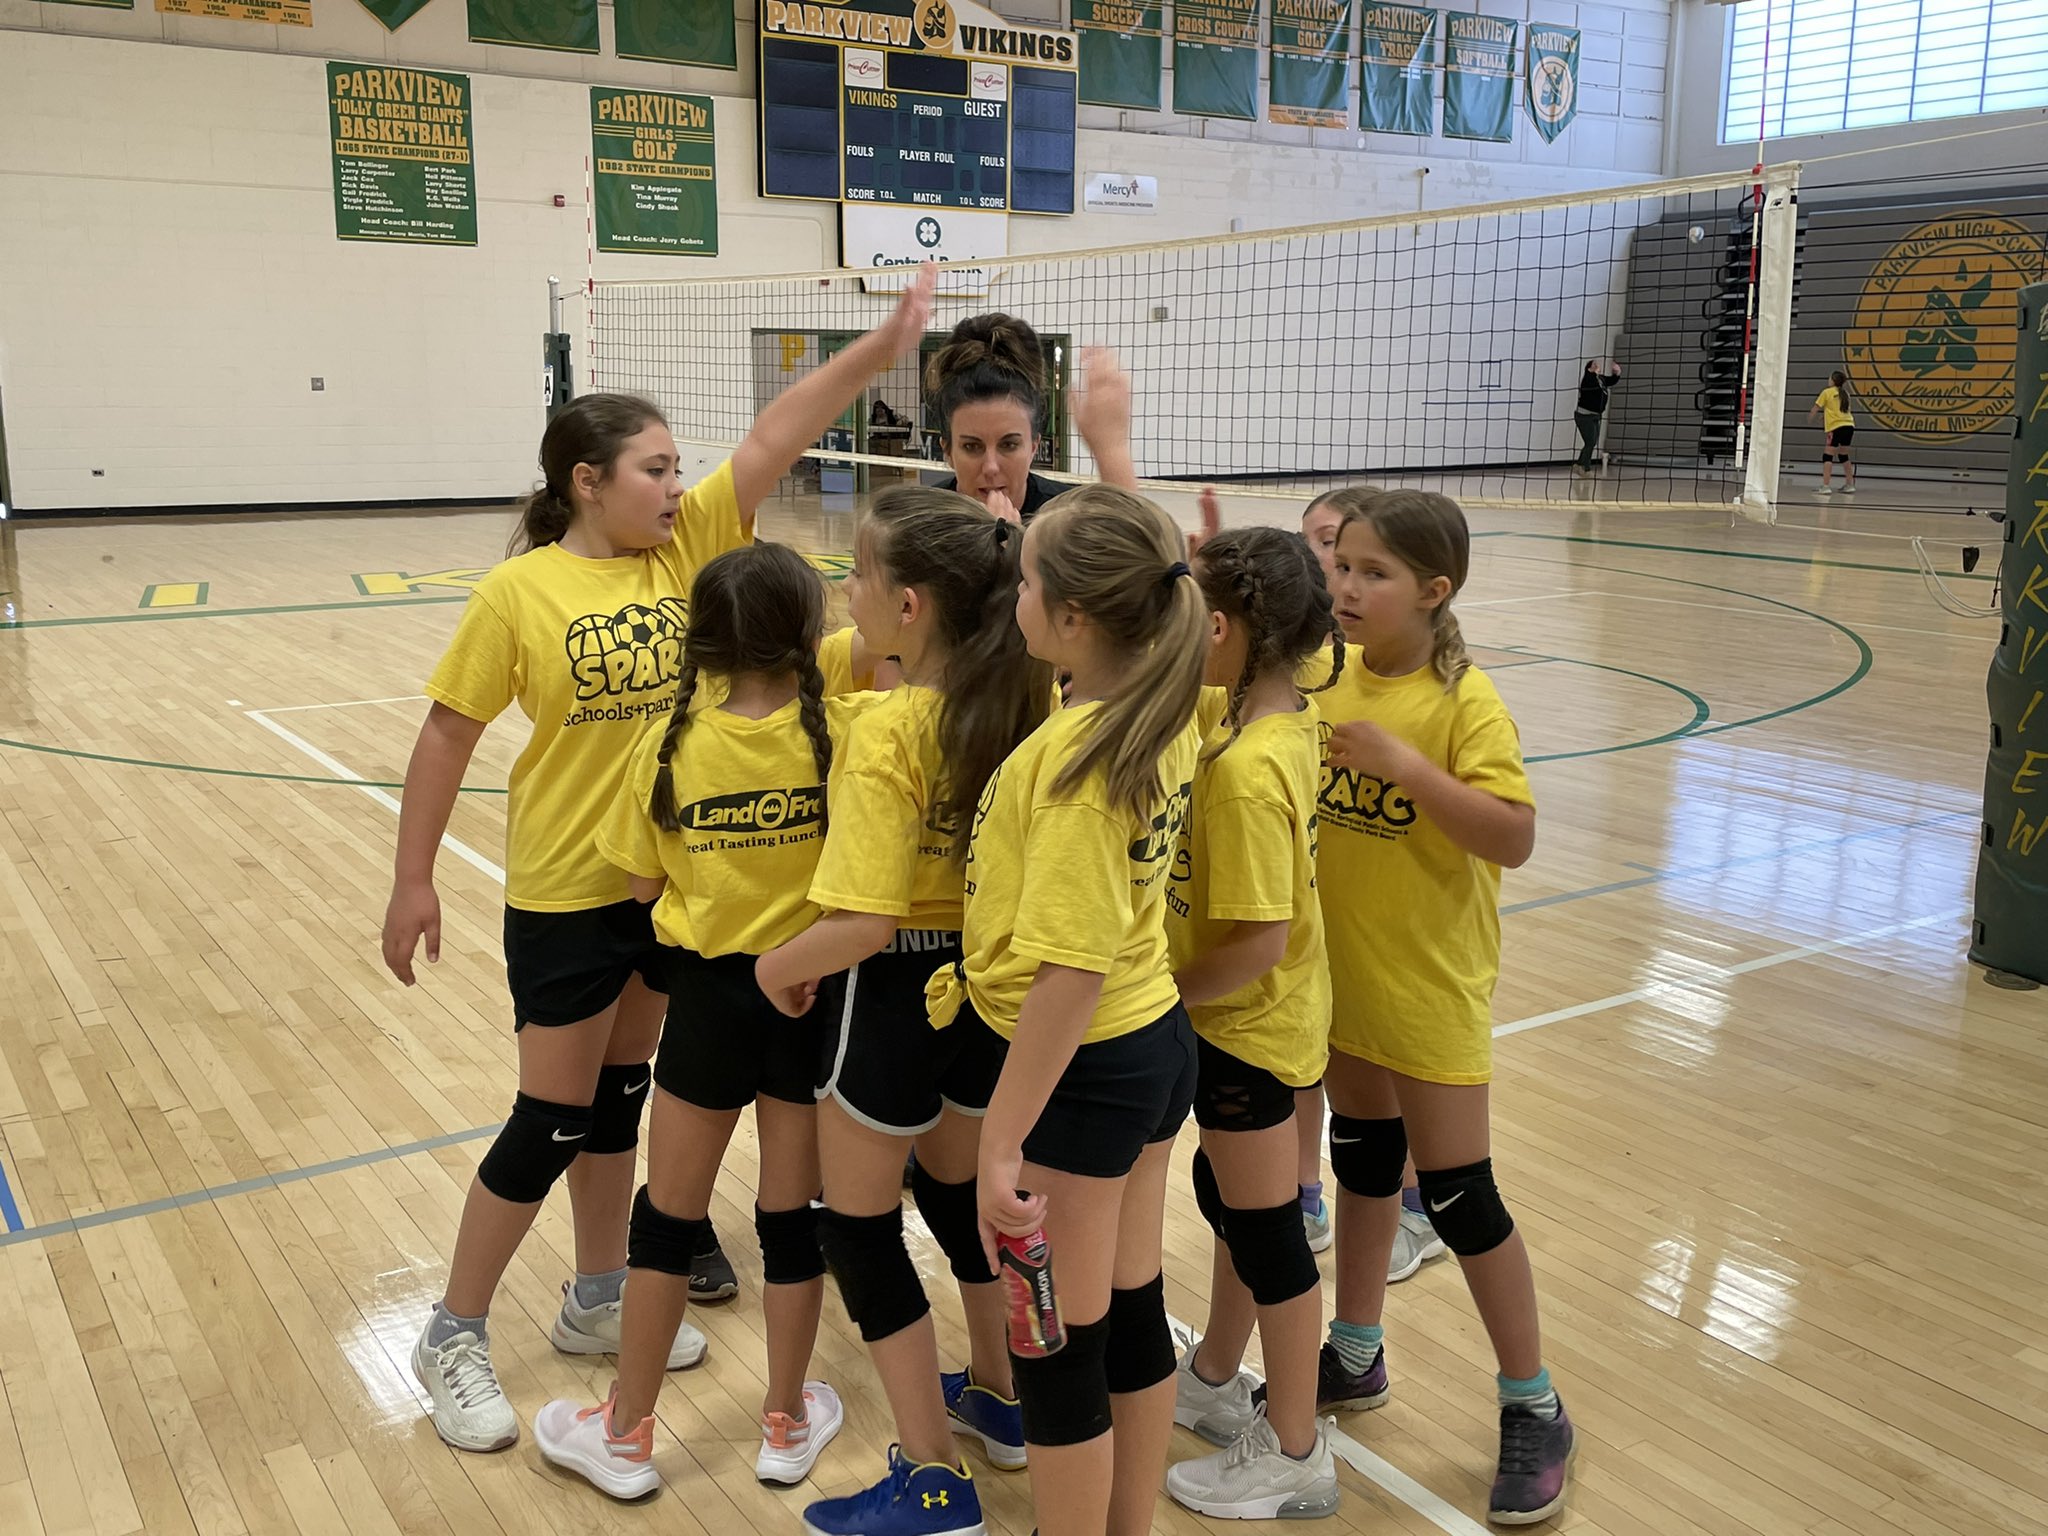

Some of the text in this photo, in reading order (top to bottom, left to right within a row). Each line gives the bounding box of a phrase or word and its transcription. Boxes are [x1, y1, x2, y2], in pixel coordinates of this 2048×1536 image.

[1092, 4, 1144, 26] SOCCER
[1206, 8, 1233, 19] GIRLS
[1277, 0, 1344, 21] PARKVIEW
[1366, 7, 1431, 32] PARKVIEW
[767, 0, 1073, 63] PARKVIEW VIKINGS
[1177, 16, 1211, 35] CROSS
[1215, 19, 1259, 40] COUNTRY
[1300, 20, 1325, 32] GIRLS
[1452, 17, 1514, 43] PARKVIEW
[1298, 31, 1327, 48] GOLF
[1388, 32, 1411, 44] GIRLS
[1532, 32, 1578, 53] PARKVIEW
[1456, 50, 1507, 69] SOFTBALL
[335, 69, 462, 106] PARKVIEW
[849, 90, 898, 109] VIKINGS
[376, 102, 416, 120] GREEN
[598, 94, 707, 128] PARKVIEW
[913, 104, 943, 117] PERIOD
[964, 101, 1002, 118] GUEST
[339, 116, 467, 147] BASKETBALL
[635, 126, 673, 141] GIRLS
[362, 144, 389, 155] STATE
[392, 147, 439, 159] CHAMPIONS
[442, 150, 468, 161] (27-1)
[632, 139, 677, 161] GOLF
[847, 145, 874, 157] FOULS
[899, 150, 955, 164] PLAYER FOUL
[626, 163, 656, 173] STATE
[659, 165, 711, 177] CHAMPIONS
[980, 156, 1005, 167] FOULS
[341, 167, 359, 175] Larry
[848, 188, 875, 200] SCORE
[913, 193, 942, 204] MATCH
[1103, 183, 1131, 198] Mercy
[635, 202, 655, 211] Cindy
[980, 197, 1005, 208] SCORE
[426, 221, 454, 229] Harding
[1874, 225, 1949, 290] PARKVIEW
[1955, 222, 1995, 241] HIGH
[1902, 381, 1972, 407] VIKINGS
[1867, 386, 2015, 432] Springfield Missouri
[571, 638, 686, 701] SPAR
[1318, 764, 1416, 827] PARC
[692, 800, 755, 828] Land
[684, 840, 713, 854] reat
[717, 836, 776, 850] Tasting
[880, 928, 962, 954] UNDE
